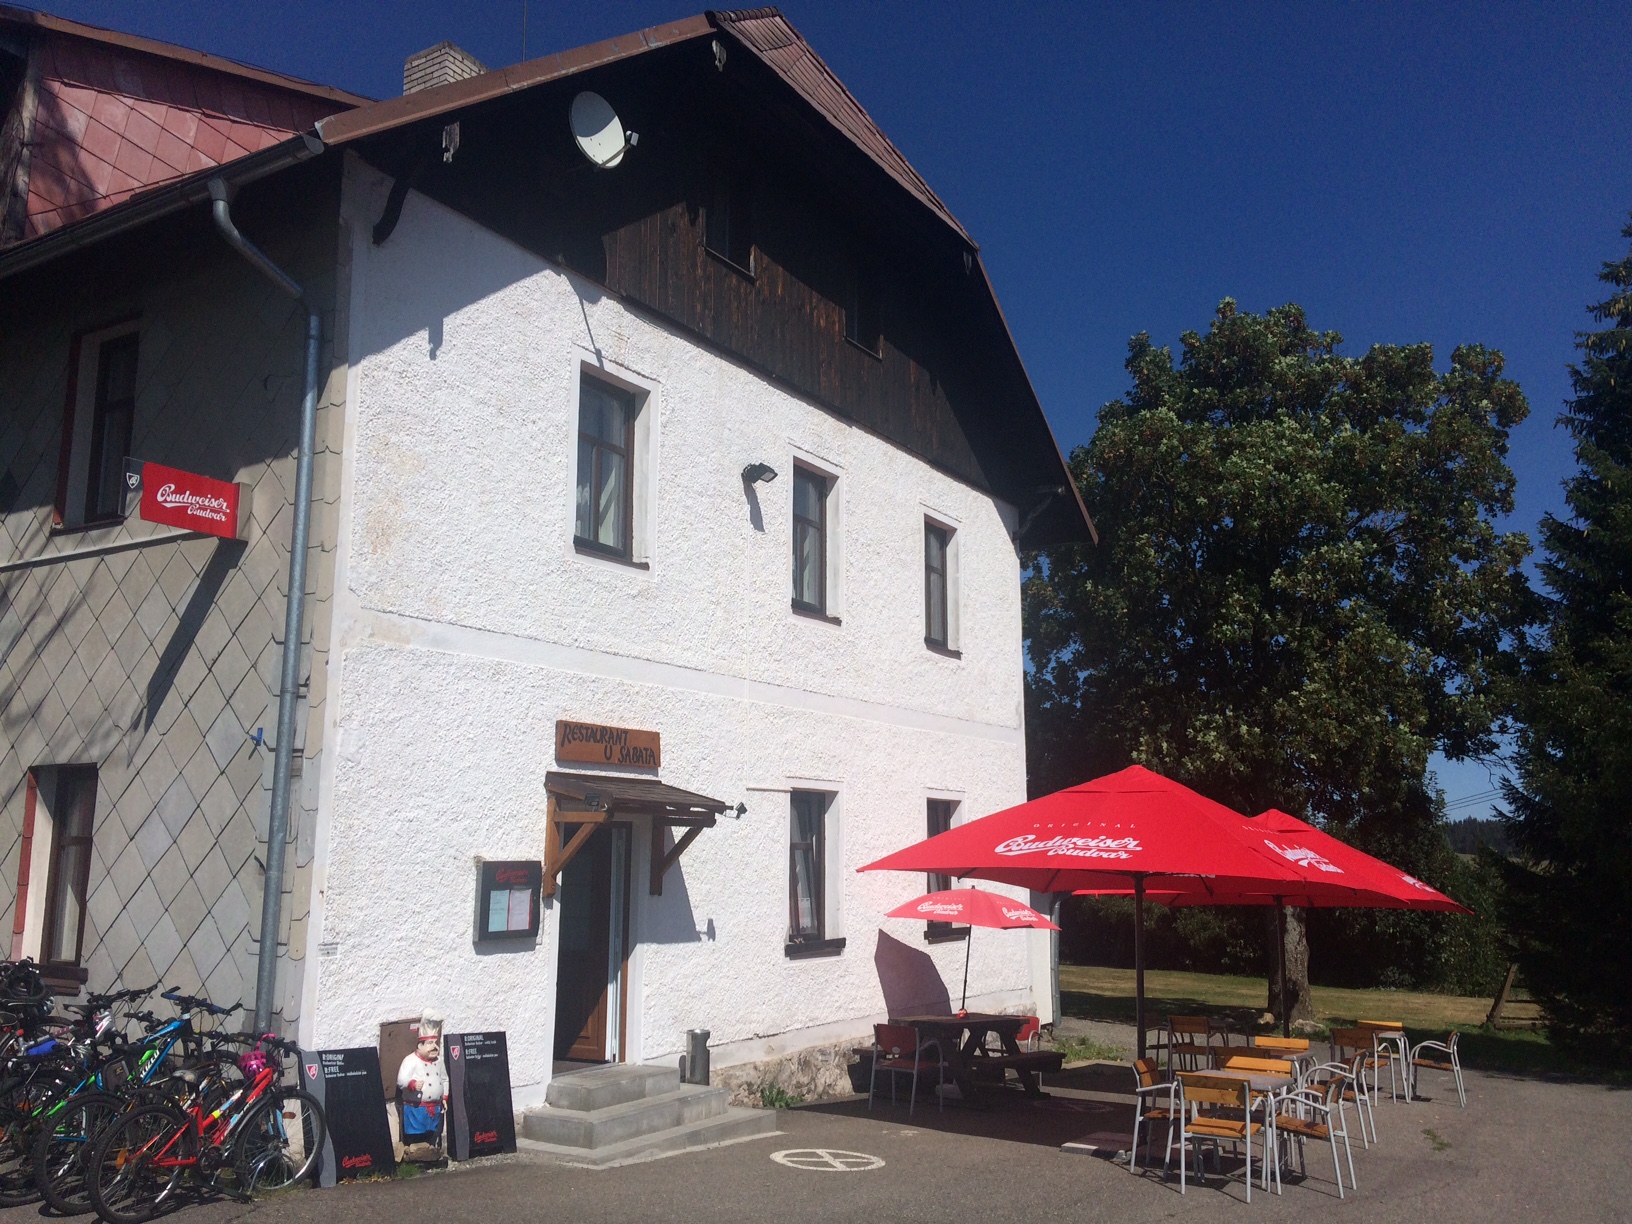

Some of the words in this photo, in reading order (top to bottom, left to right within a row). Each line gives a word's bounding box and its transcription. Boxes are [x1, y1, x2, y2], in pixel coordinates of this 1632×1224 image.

[157, 484, 230, 512] Budweiser
[187, 504, 227, 521] Budvar
[561, 723, 628, 748] RESTAURANT
[604, 744, 613, 761] U
[618, 745, 656, 765] SABATA
[1033, 821, 1136, 829] ORIGINAL
[994, 834, 1143, 856] Budweiser
[1047, 845, 1133, 859] Budvar
